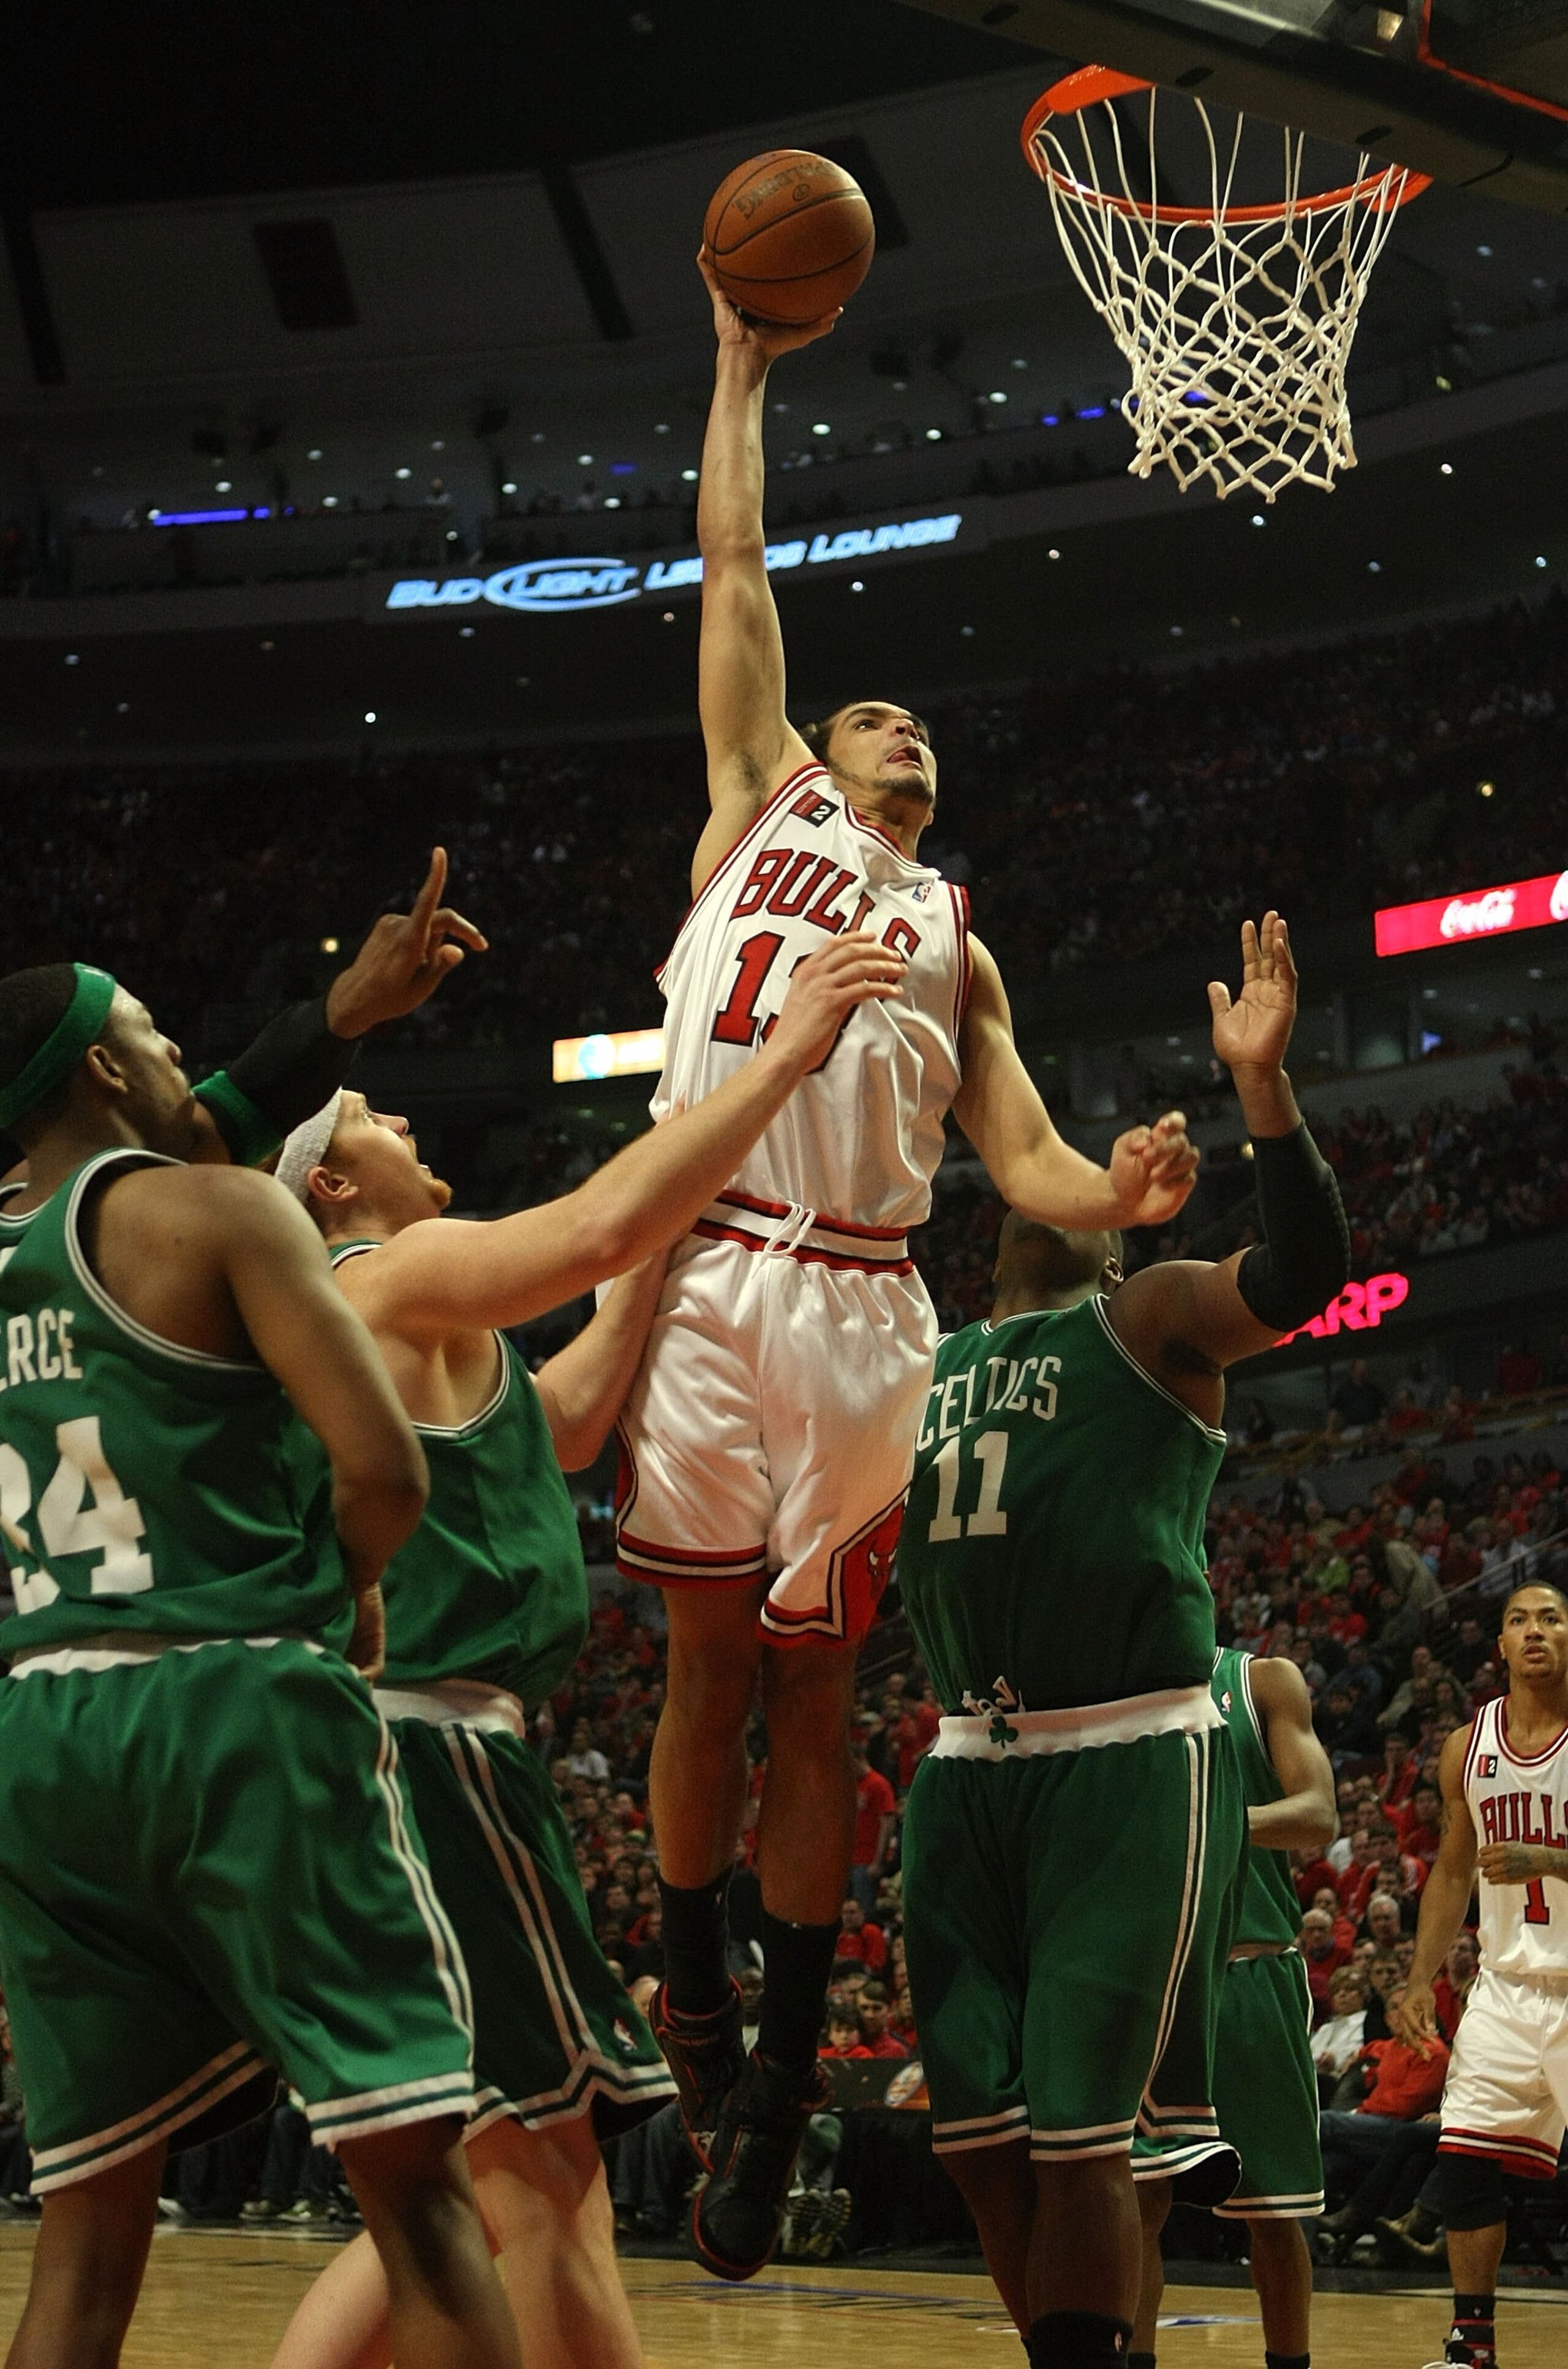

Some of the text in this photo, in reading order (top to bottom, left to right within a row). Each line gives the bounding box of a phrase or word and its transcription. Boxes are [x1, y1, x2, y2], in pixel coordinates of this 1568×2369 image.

[386, 578, 483, 609] BUD
[507, 567, 638, 599] LIGHT
[807, 514, 962, 563] LOUNGE
[811, 805, 831, 820] 2
[0, 1308, 84, 1393] RCE
[928, 1430, 1009, 1543] 11
[1479, 1791, 1568, 1849] BULL
